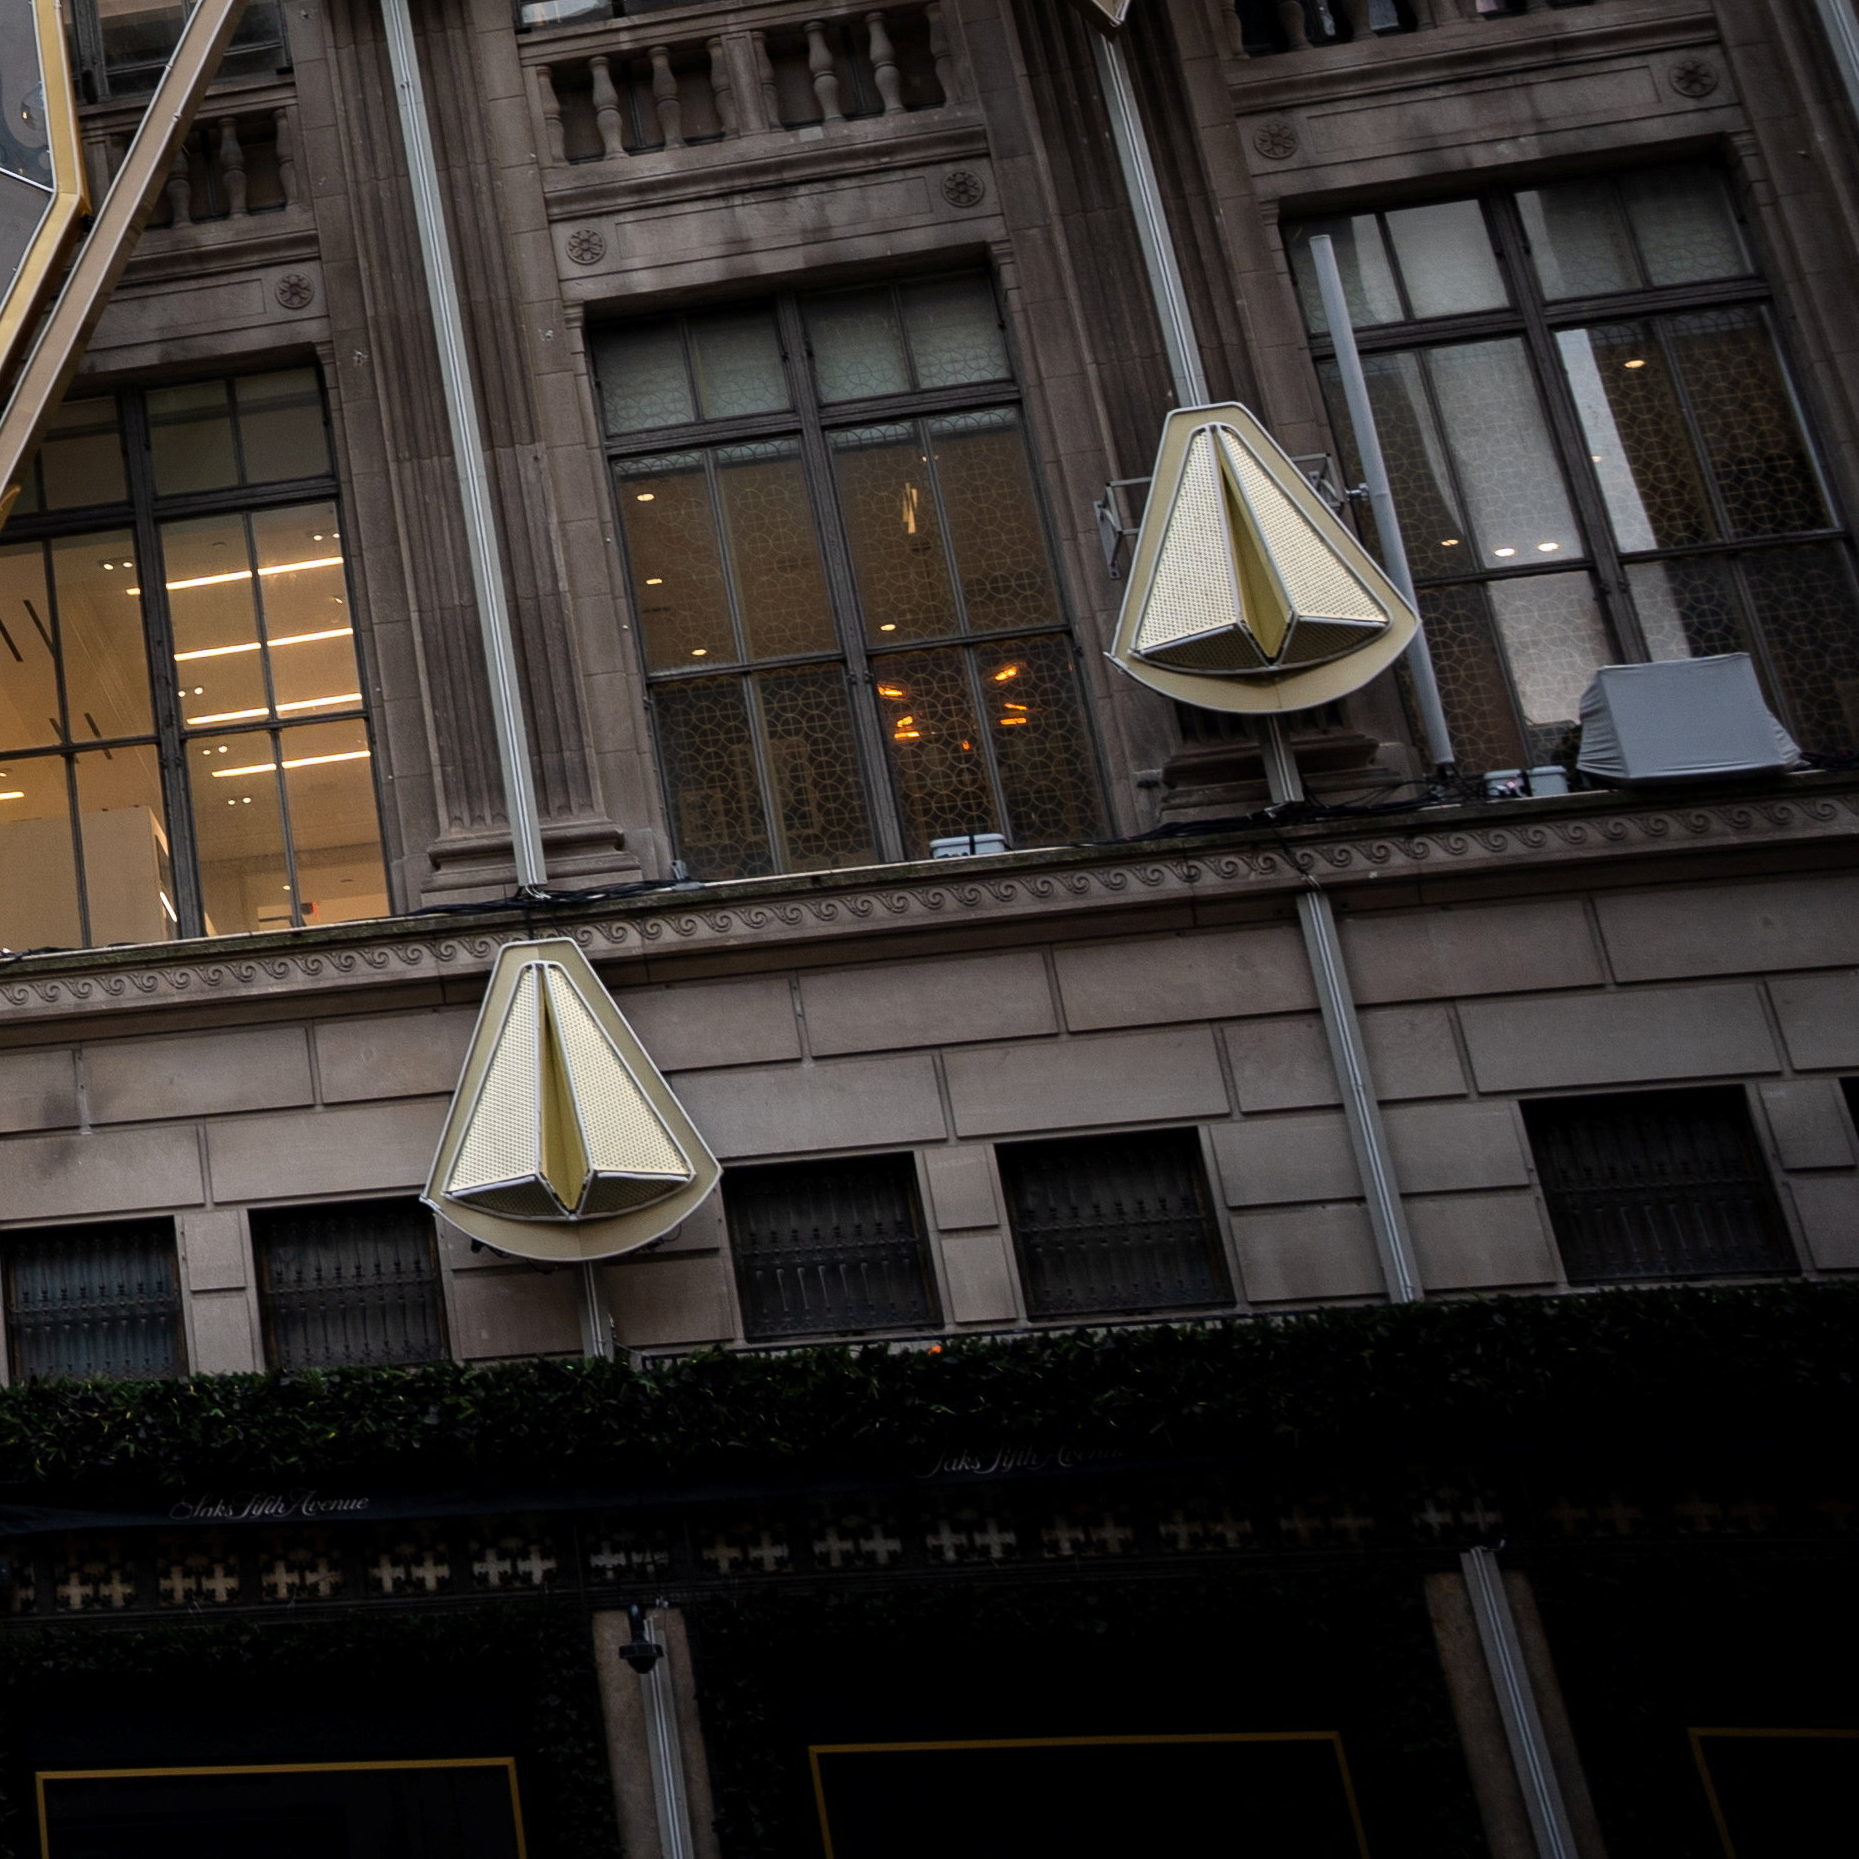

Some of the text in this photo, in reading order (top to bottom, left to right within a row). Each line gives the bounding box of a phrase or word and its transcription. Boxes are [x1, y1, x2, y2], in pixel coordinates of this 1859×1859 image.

[168, 1487, 371, 1520] Saks Fifth Avenue
